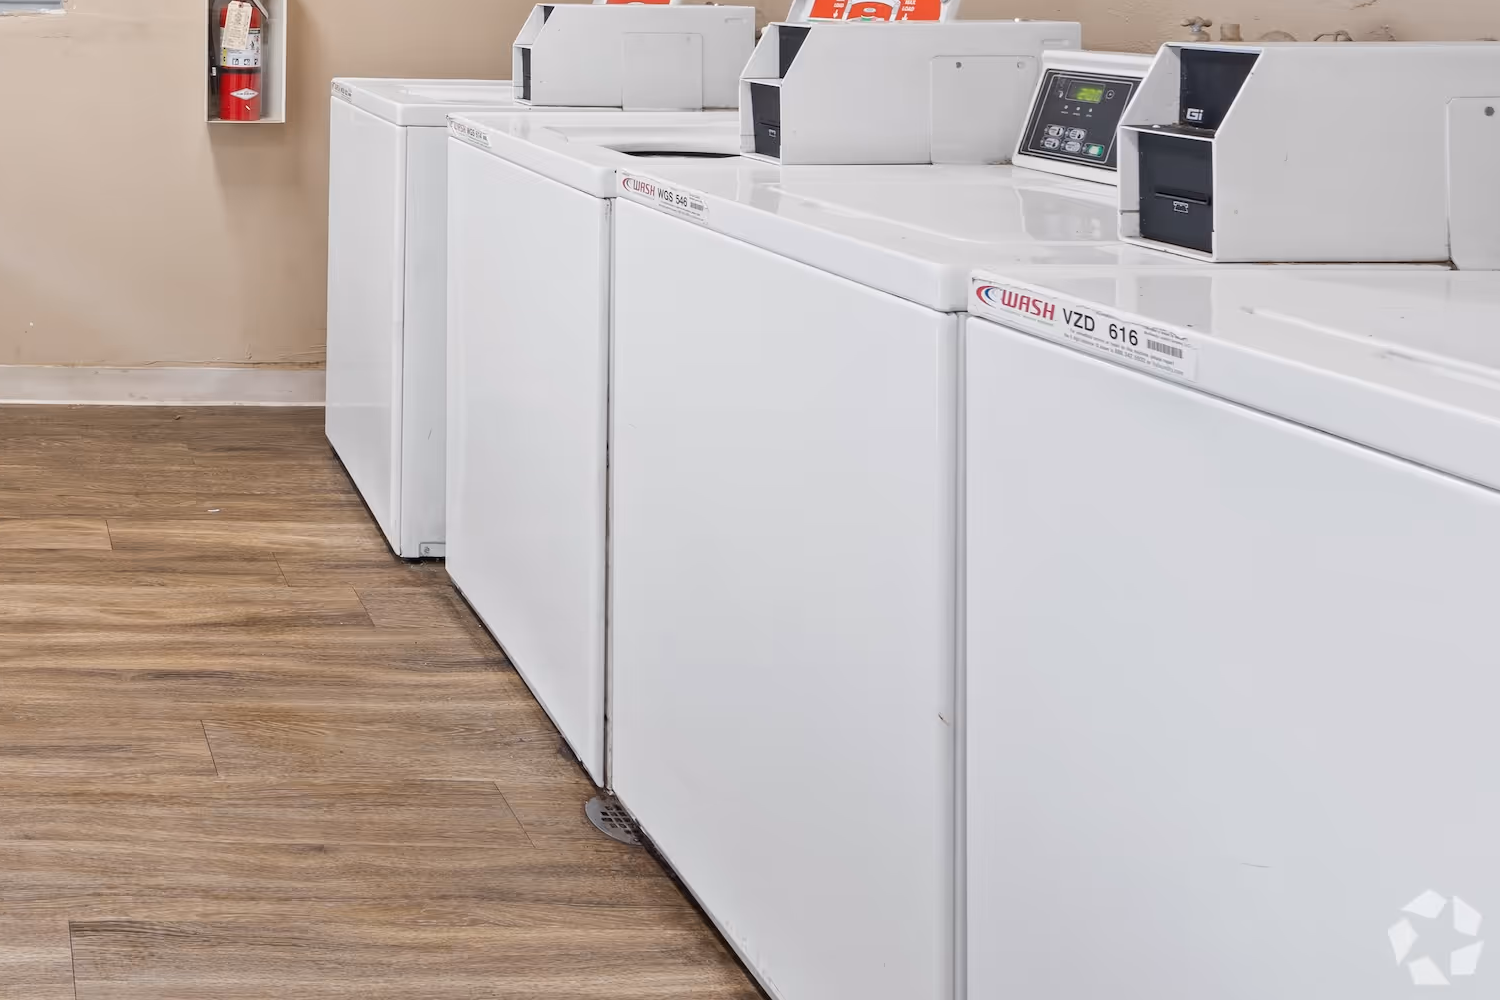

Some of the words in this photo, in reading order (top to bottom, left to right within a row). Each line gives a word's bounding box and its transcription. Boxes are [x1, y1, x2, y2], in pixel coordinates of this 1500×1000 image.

[633, 179, 656, 197] WASH
[657, 187, 674, 203] WGS
[675, 194, 688, 208] 546
[1000, 289, 1056, 321] WASH
[1062, 308, 1096, 332] VZD
[1108, 323, 1139, 346] 616
